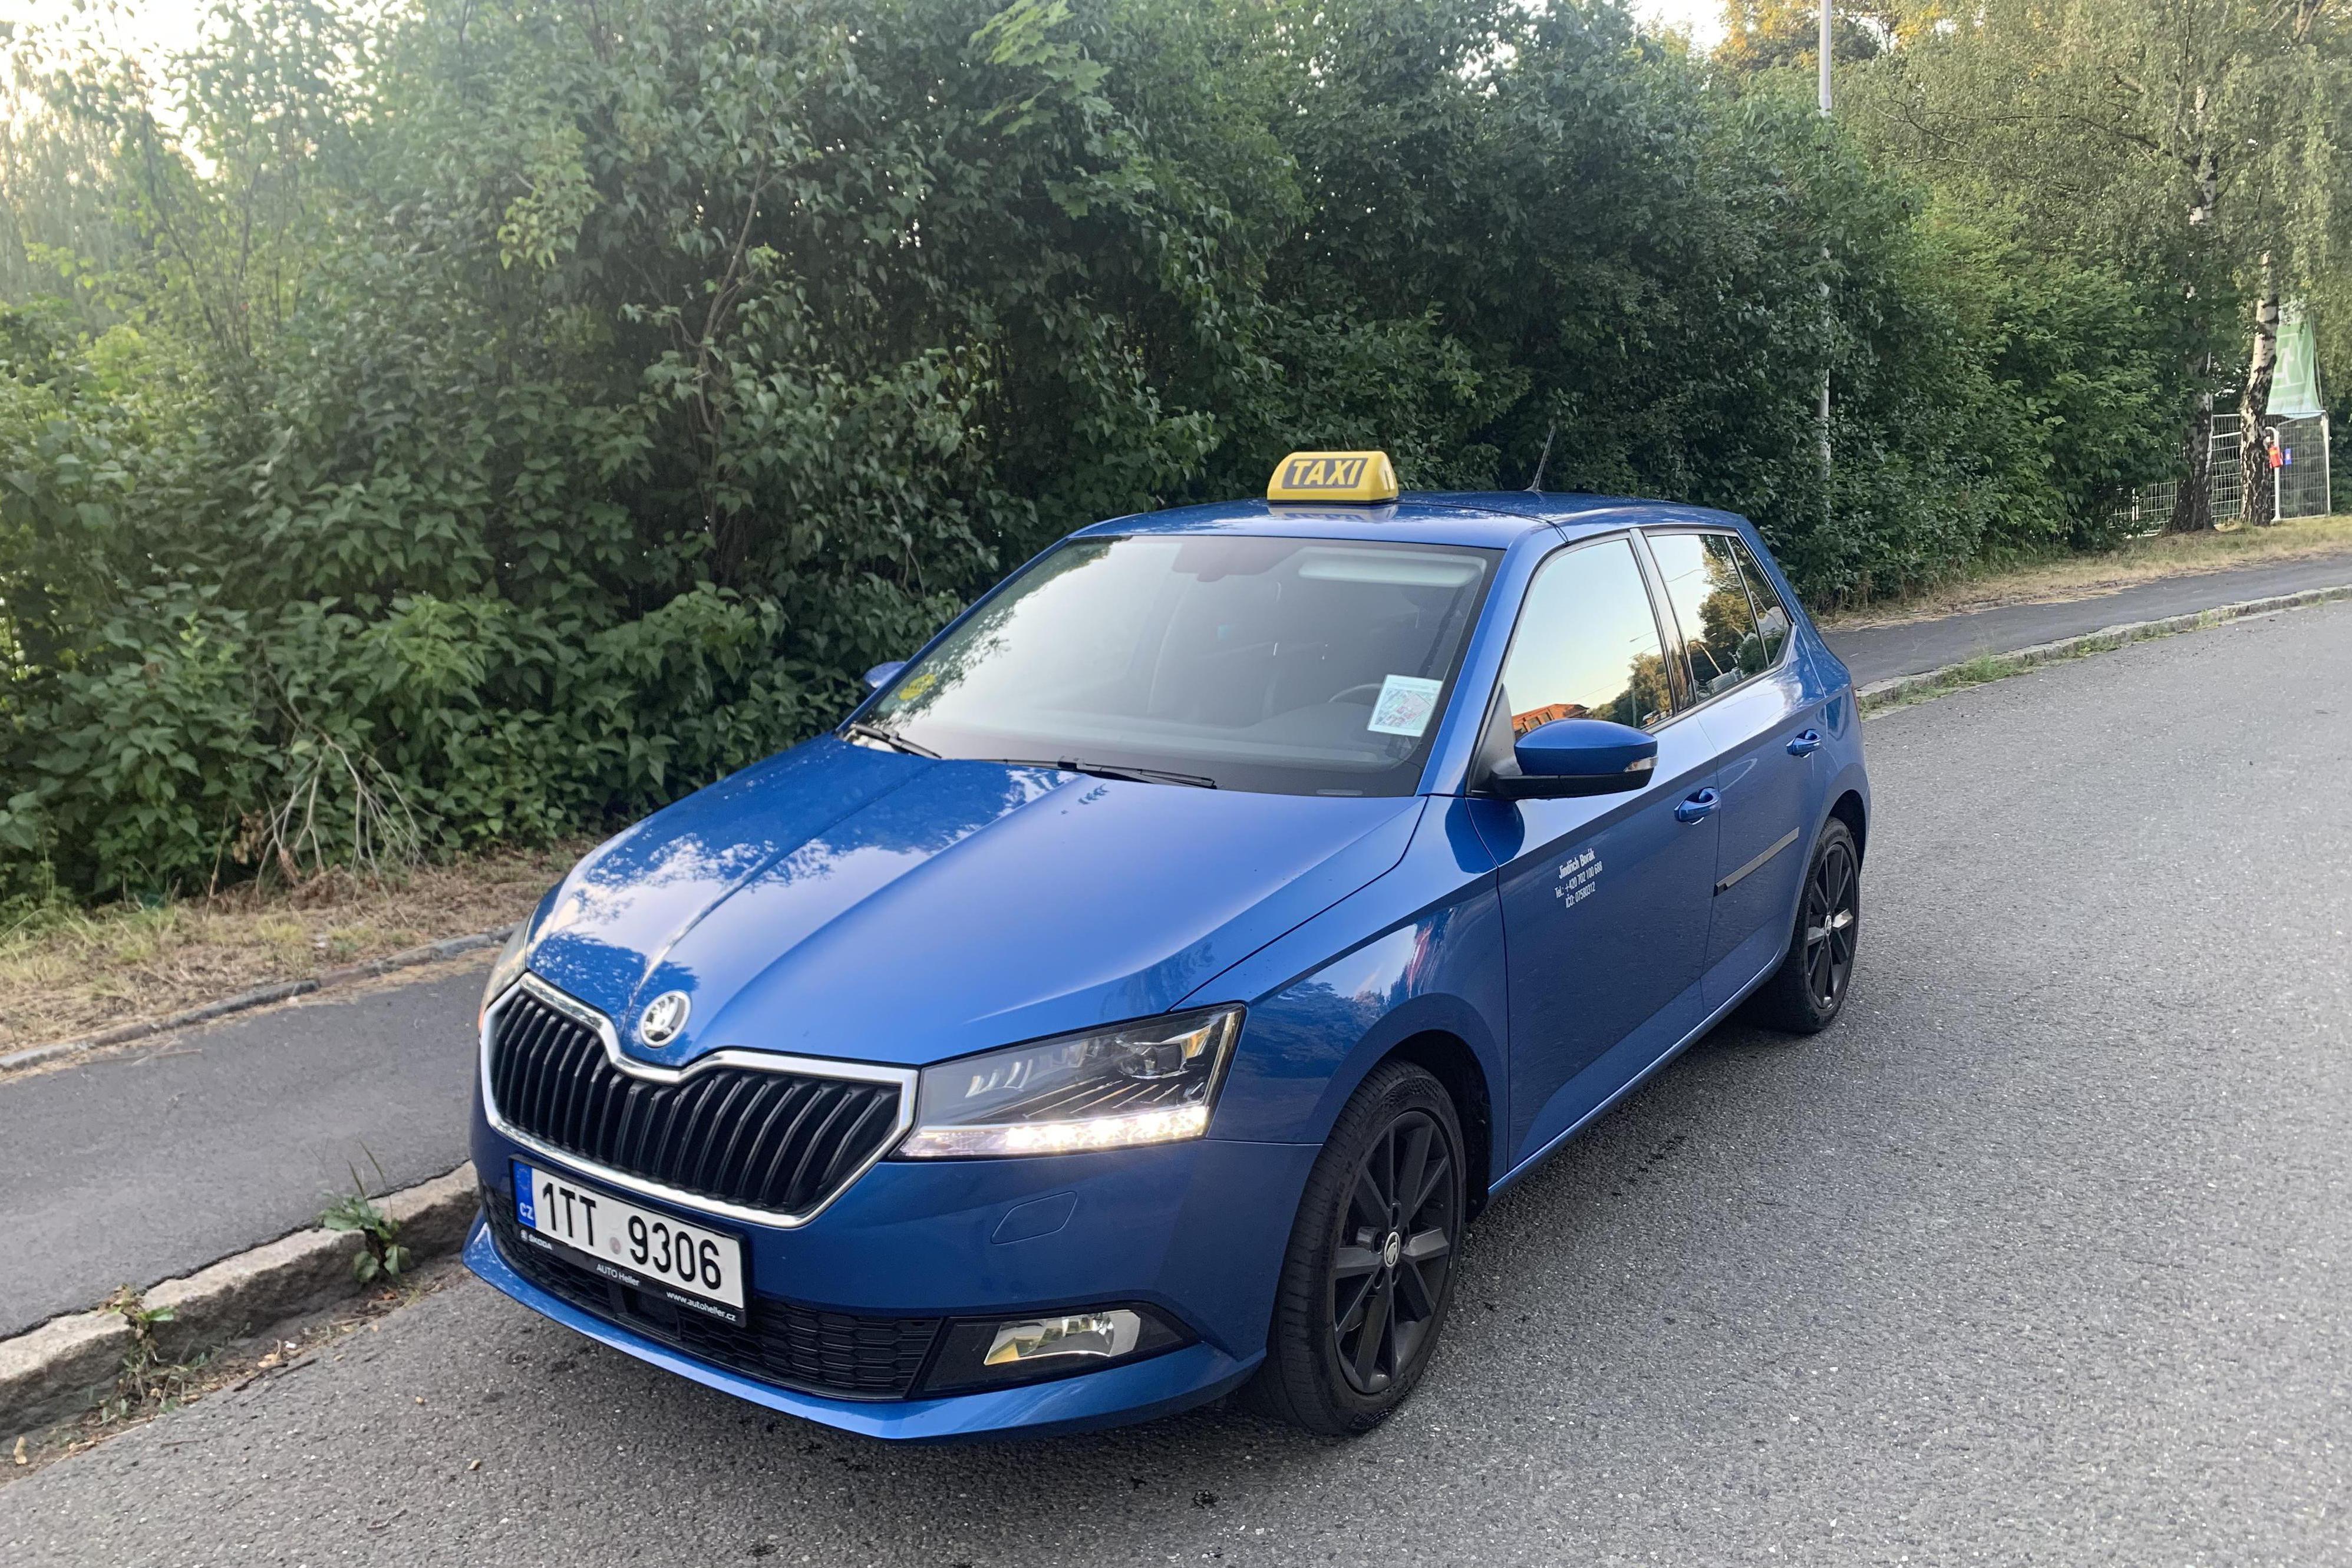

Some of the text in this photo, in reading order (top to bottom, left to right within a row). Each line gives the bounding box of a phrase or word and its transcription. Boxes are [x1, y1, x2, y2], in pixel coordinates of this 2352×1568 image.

[1291, 460, 1363, 486] TAXI
[1559, 849, 1595, 879] Jindřich Borák
[1565, 877, 1577, 892] +420
[1577, 871, 1586, 884] 702
[1565, 893, 1575, 908] IČO:
[519, 1201, 535, 1221] CZ
[543, 1182, 722, 1290] 1TT 9306
[596, 1263, 640, 1287] AUTO Heller
[666, 1290, 736, 1322] www.autoheller.cz
